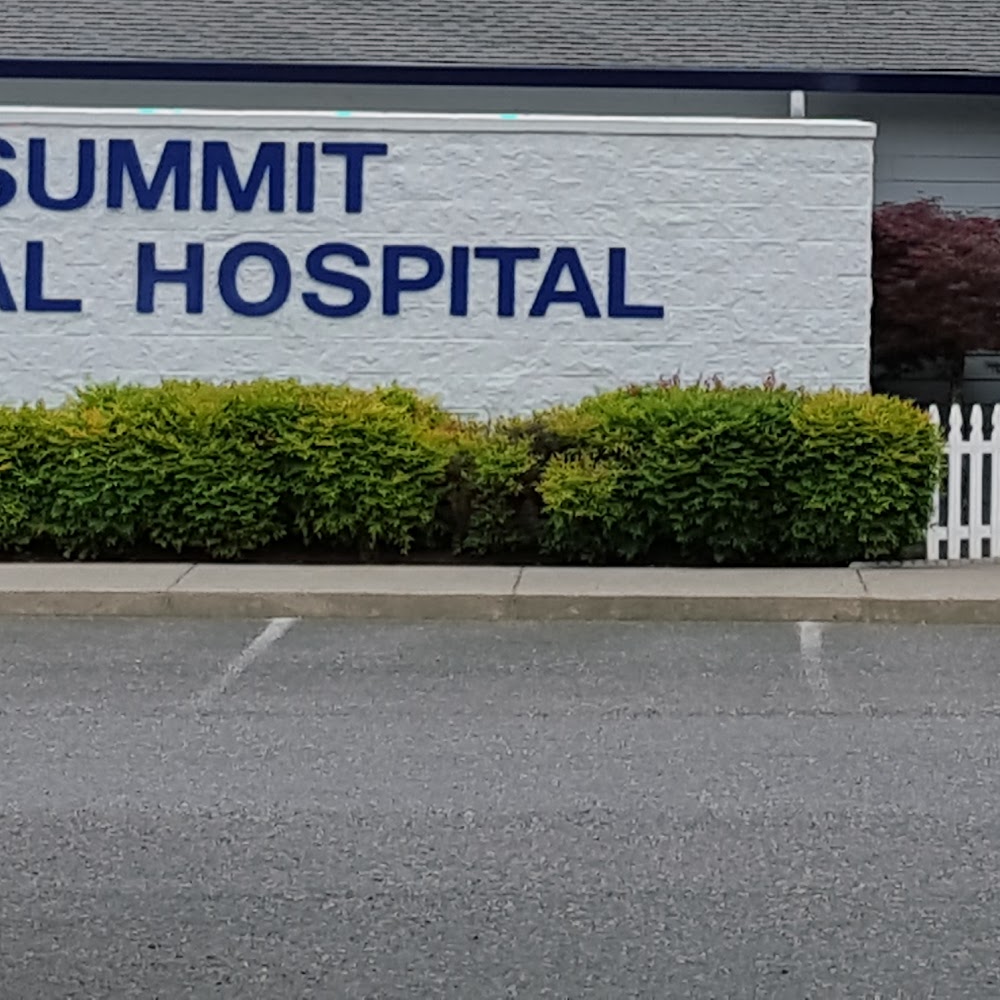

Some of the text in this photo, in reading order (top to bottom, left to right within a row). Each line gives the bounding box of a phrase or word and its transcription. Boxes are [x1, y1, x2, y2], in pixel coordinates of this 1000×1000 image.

[0, 137, 388, 214] UMMIT
[0, 240, 665, 320] L HOSPITAL
